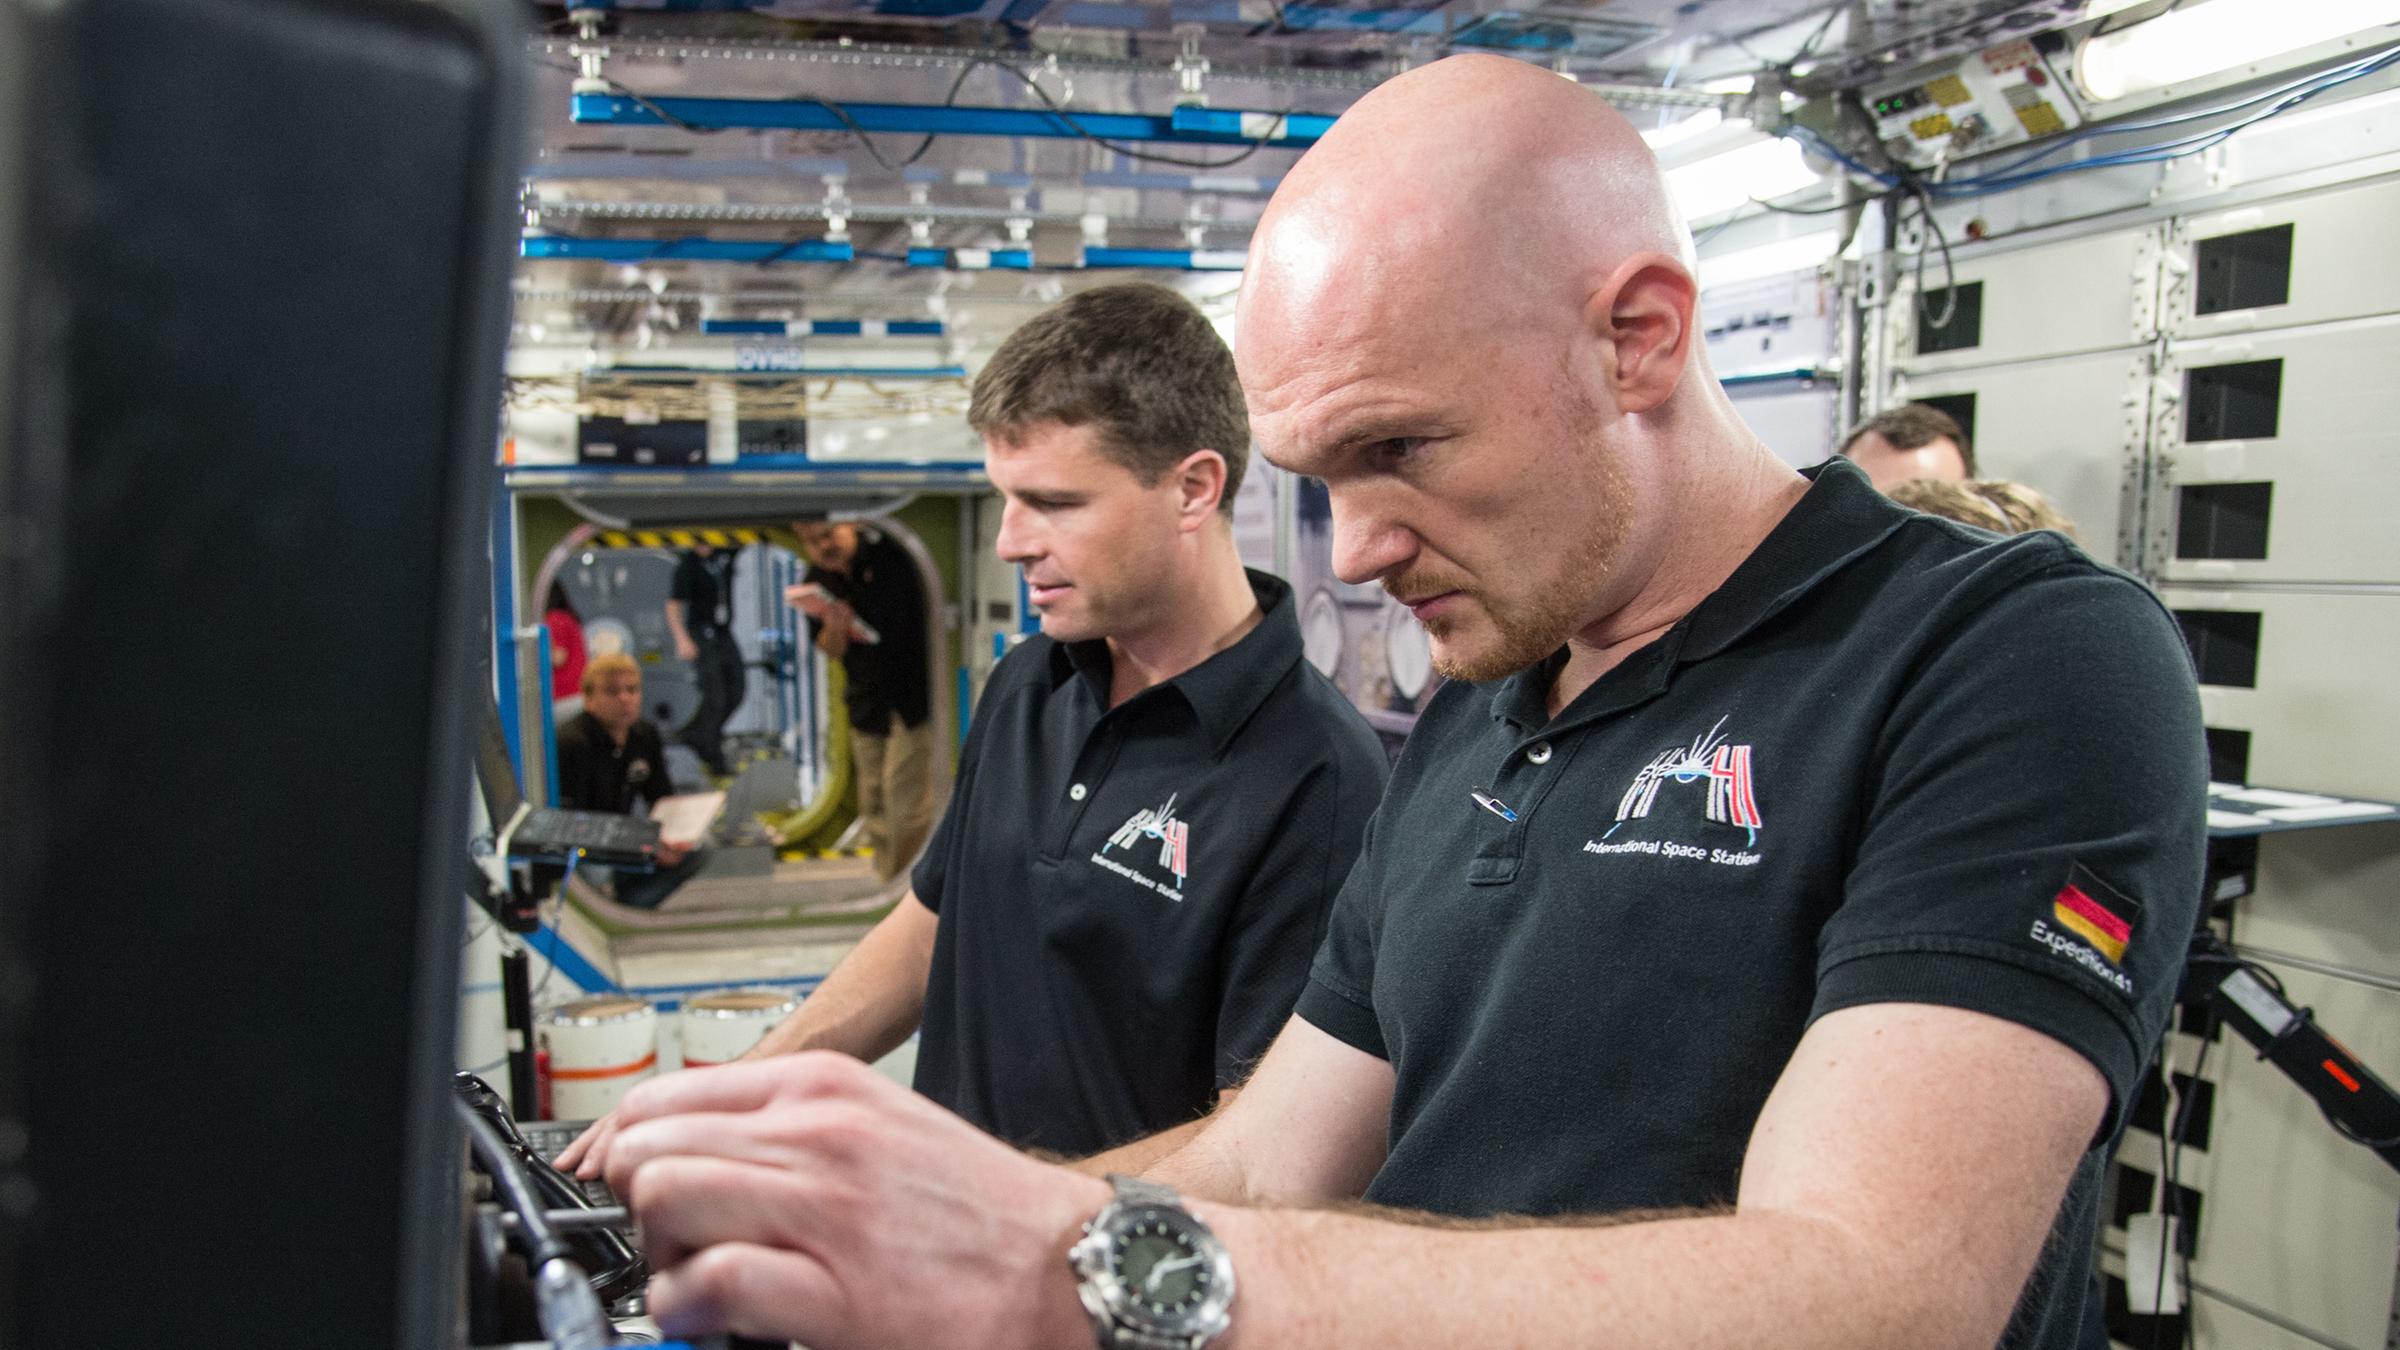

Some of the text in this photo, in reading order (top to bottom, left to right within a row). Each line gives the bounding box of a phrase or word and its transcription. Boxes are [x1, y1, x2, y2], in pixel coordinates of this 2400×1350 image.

[1583, 839, 1761, 866] International Space Station
[2029, 919, 2115, 983] Expedition
